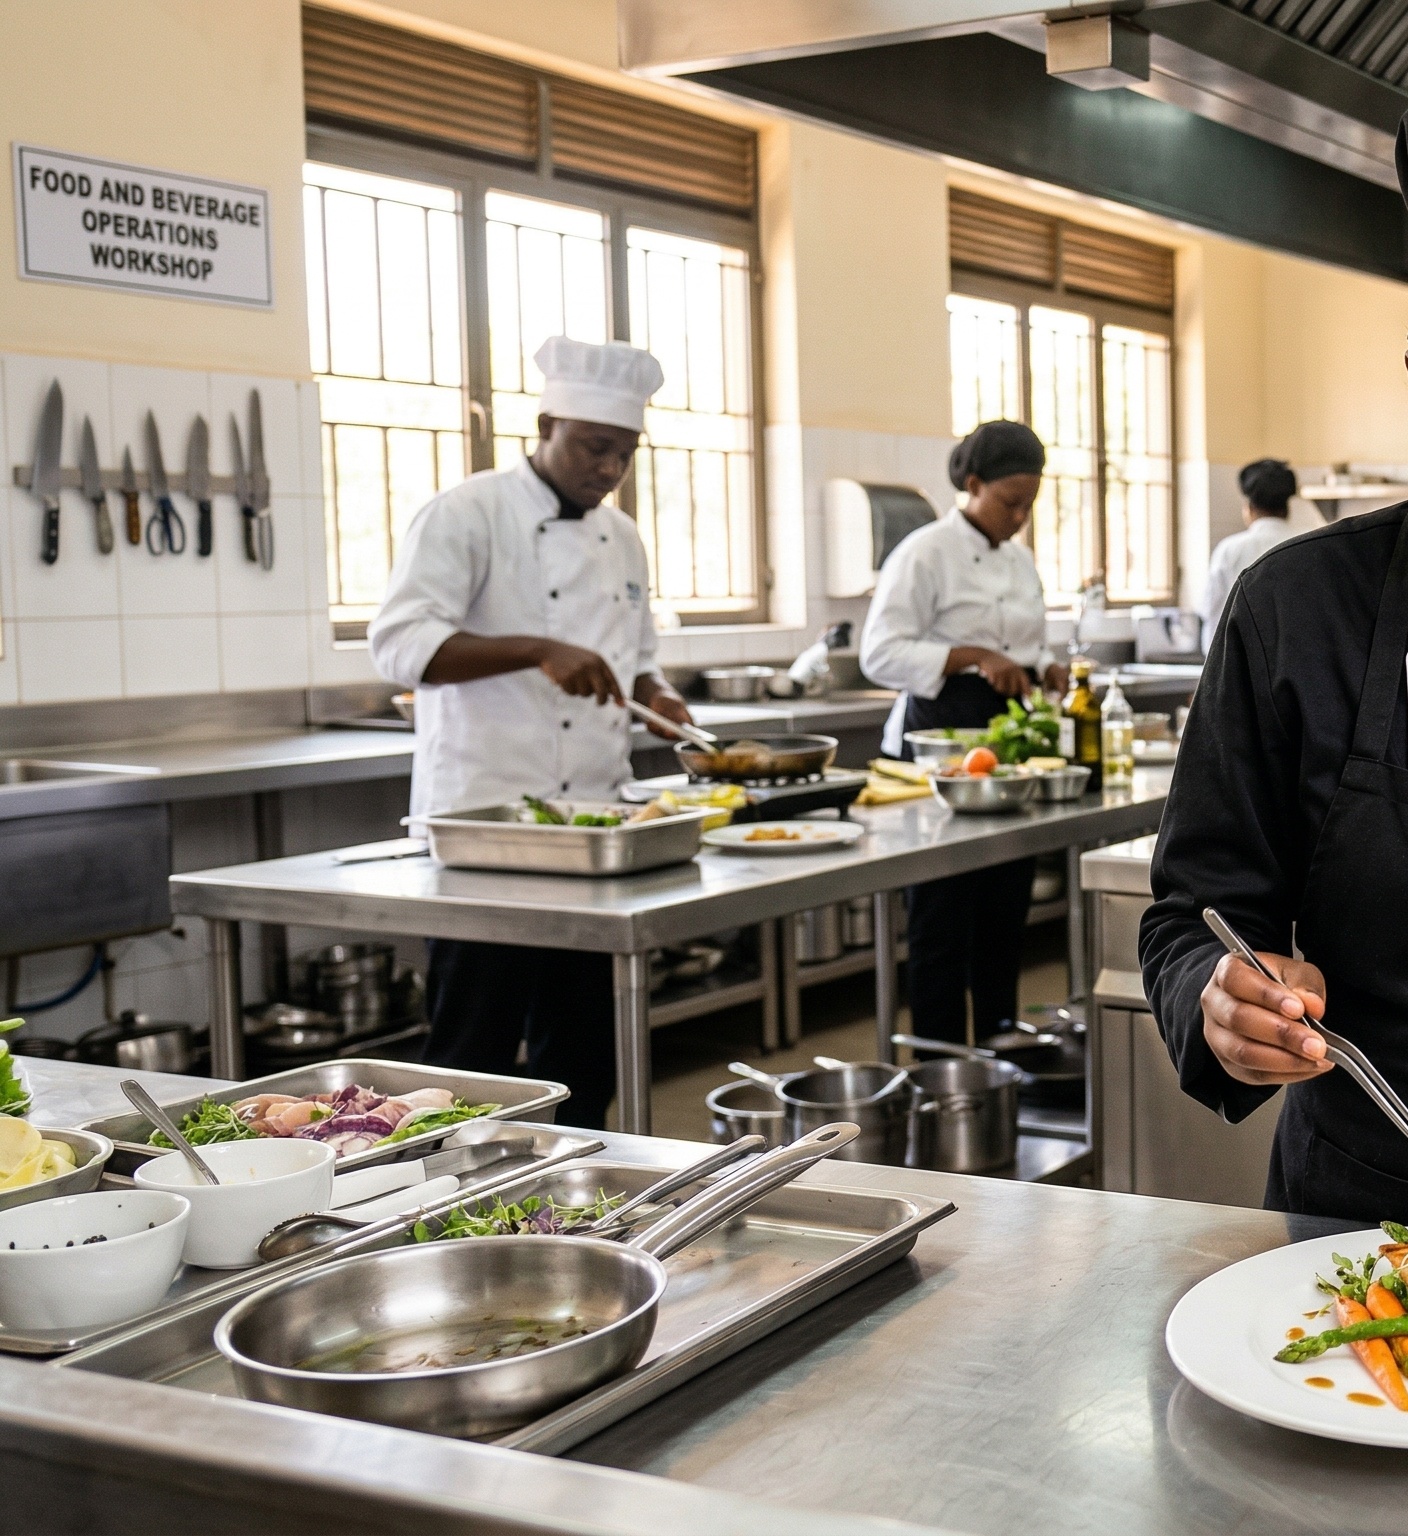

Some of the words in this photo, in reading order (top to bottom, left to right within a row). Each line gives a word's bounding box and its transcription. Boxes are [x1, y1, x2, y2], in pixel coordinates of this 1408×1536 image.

[30, 166, 91, 198] FOOD
[100, 179, 145, 206] AND
[152, 187, 261, 226] BEVERAGE
[82, 209, 218, 250] OPERATIONS
[90, 243, 213, 281] WORKSHOP
